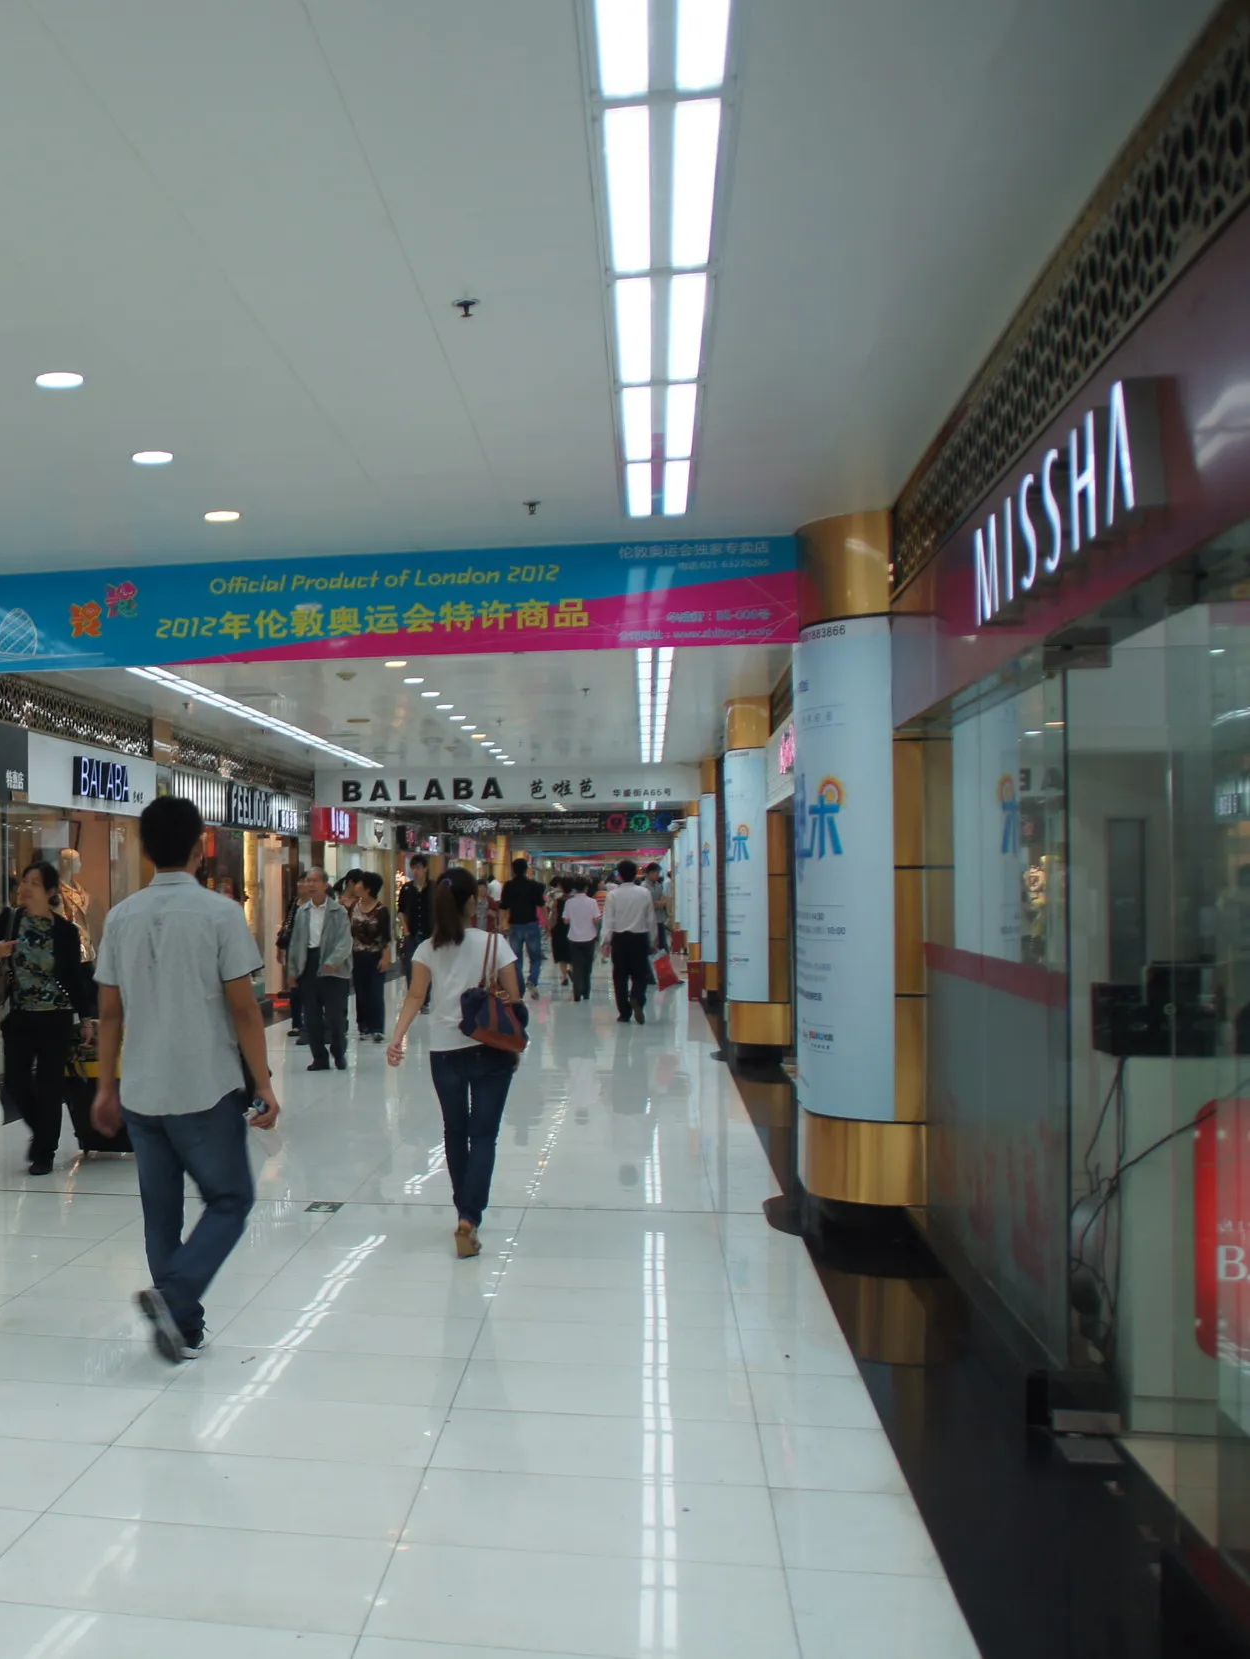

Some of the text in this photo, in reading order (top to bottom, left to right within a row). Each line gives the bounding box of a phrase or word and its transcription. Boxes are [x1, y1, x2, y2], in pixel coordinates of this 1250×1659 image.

[974, 380, 1135, 627] MISSHA
[209, 564, 561, 595] Official Product of London 2012
[155, 598, 589, 640] 2012年伦敦奥运会特许商品
[80, 756, 130, 801] BALABA
[341, 777, 504, 802] BALABA
